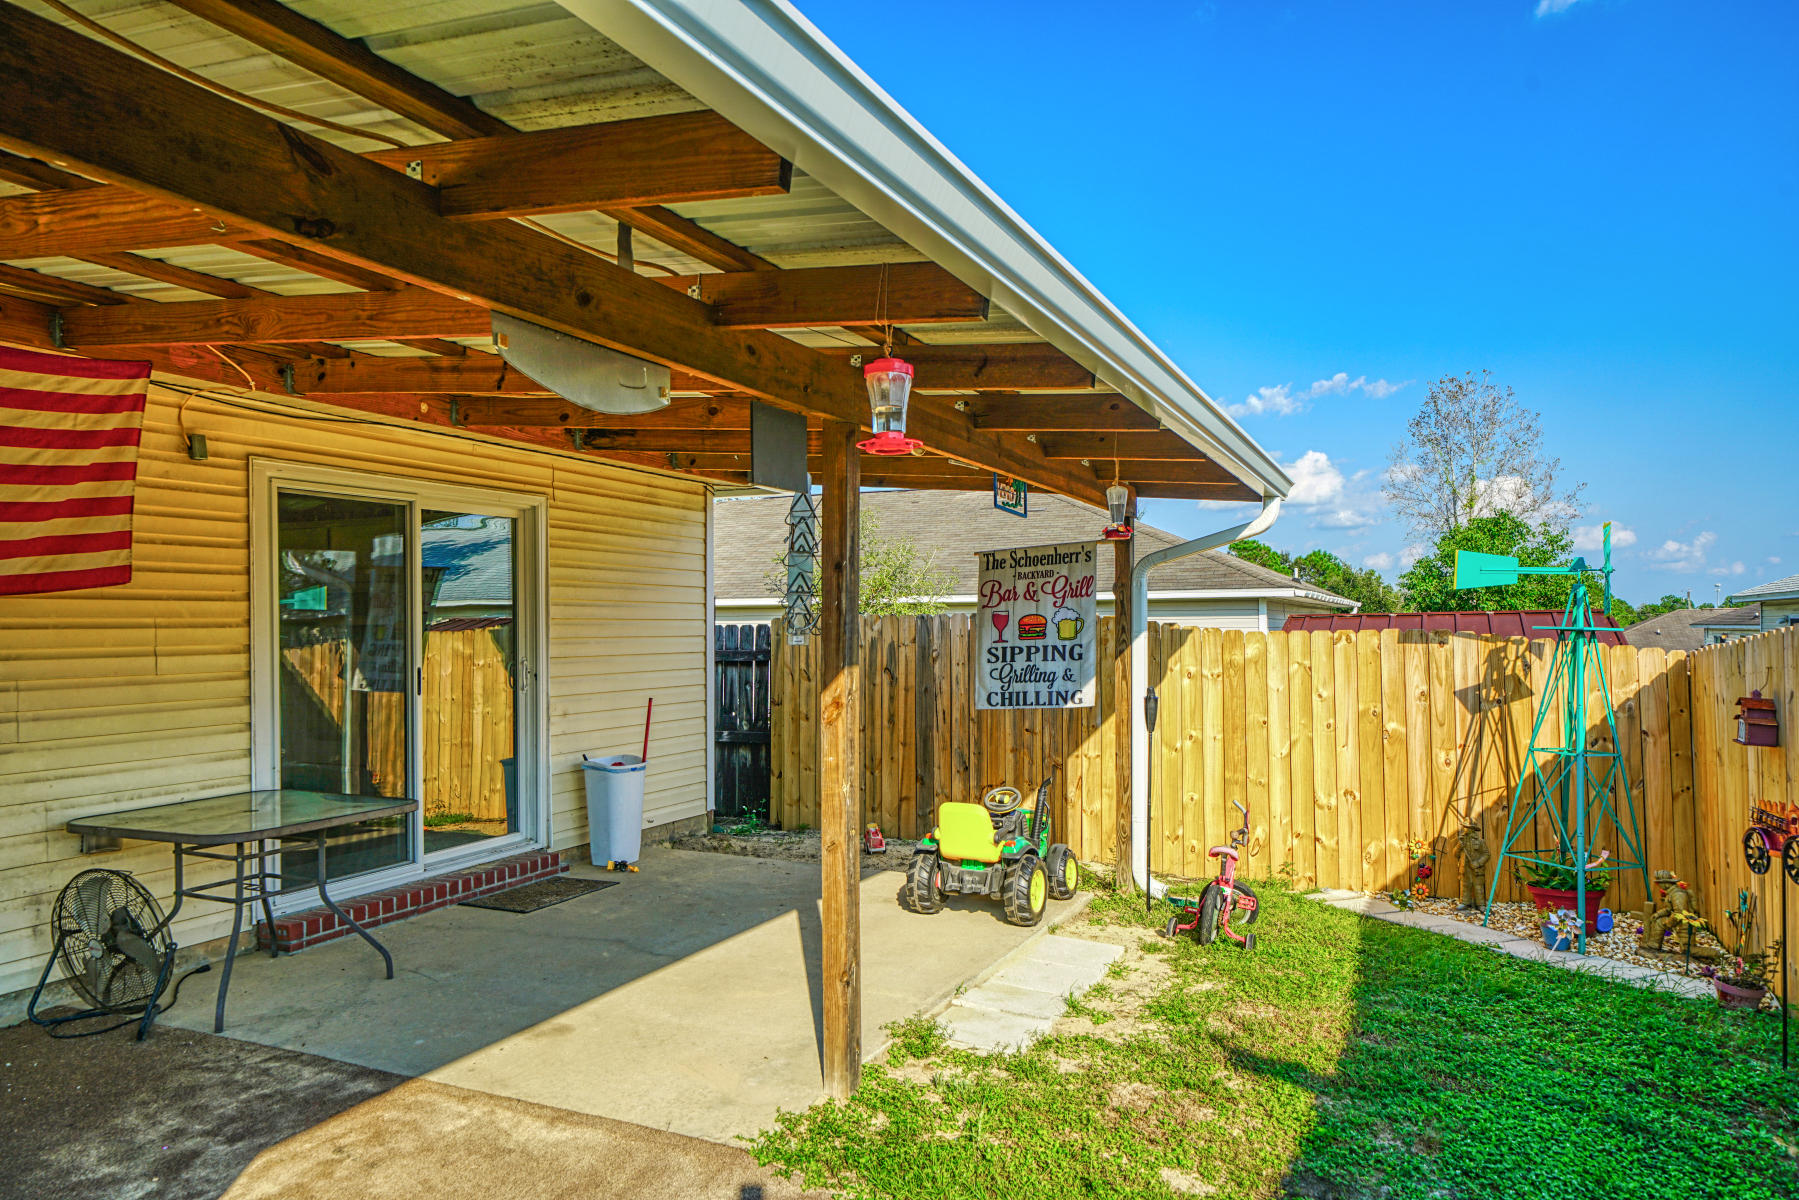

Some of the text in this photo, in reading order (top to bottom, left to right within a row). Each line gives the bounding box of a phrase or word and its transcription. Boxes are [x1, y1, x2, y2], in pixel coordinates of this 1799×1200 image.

[983, 544, 1092, 571] The Schoenherr's
[1017, 569, 1055, 580] BACKYARD
[980, 574, 1094, 609] Bar & Grill
[986, 643, 1083, 664] SIPPING
[989, 663, 1077, 691] Grilling &
[986, 689, 1084, 707] CHILLING
